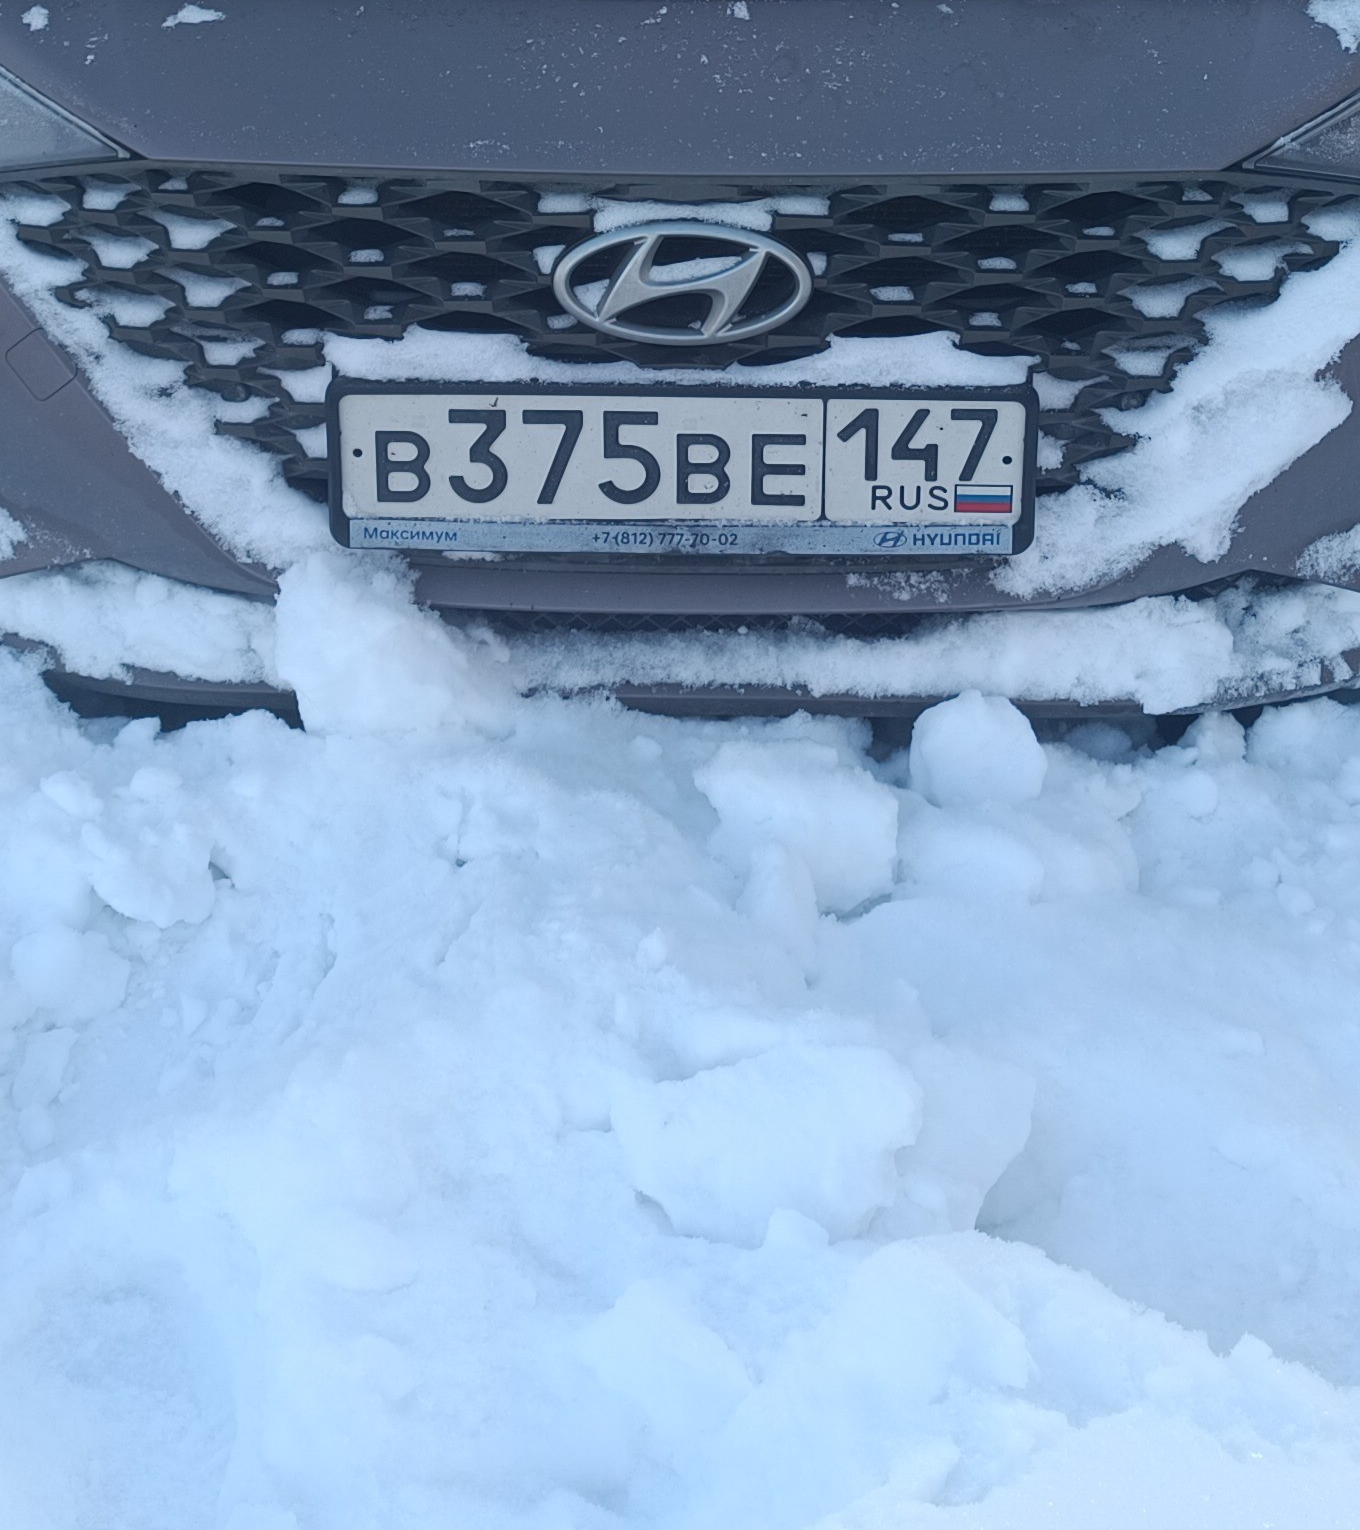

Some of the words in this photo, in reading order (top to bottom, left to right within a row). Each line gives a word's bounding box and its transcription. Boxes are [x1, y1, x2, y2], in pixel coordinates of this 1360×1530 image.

[375, 408, 807, 506] В375ВЕ
[837, 408, 999, 482] 147
[871, 484, 949, 511] RUS
[363, 526, 458, 543] Максимум
[657, 531, 739, 548] 777-70-02
[912, 531, 1002, 547] HYUNDAI
